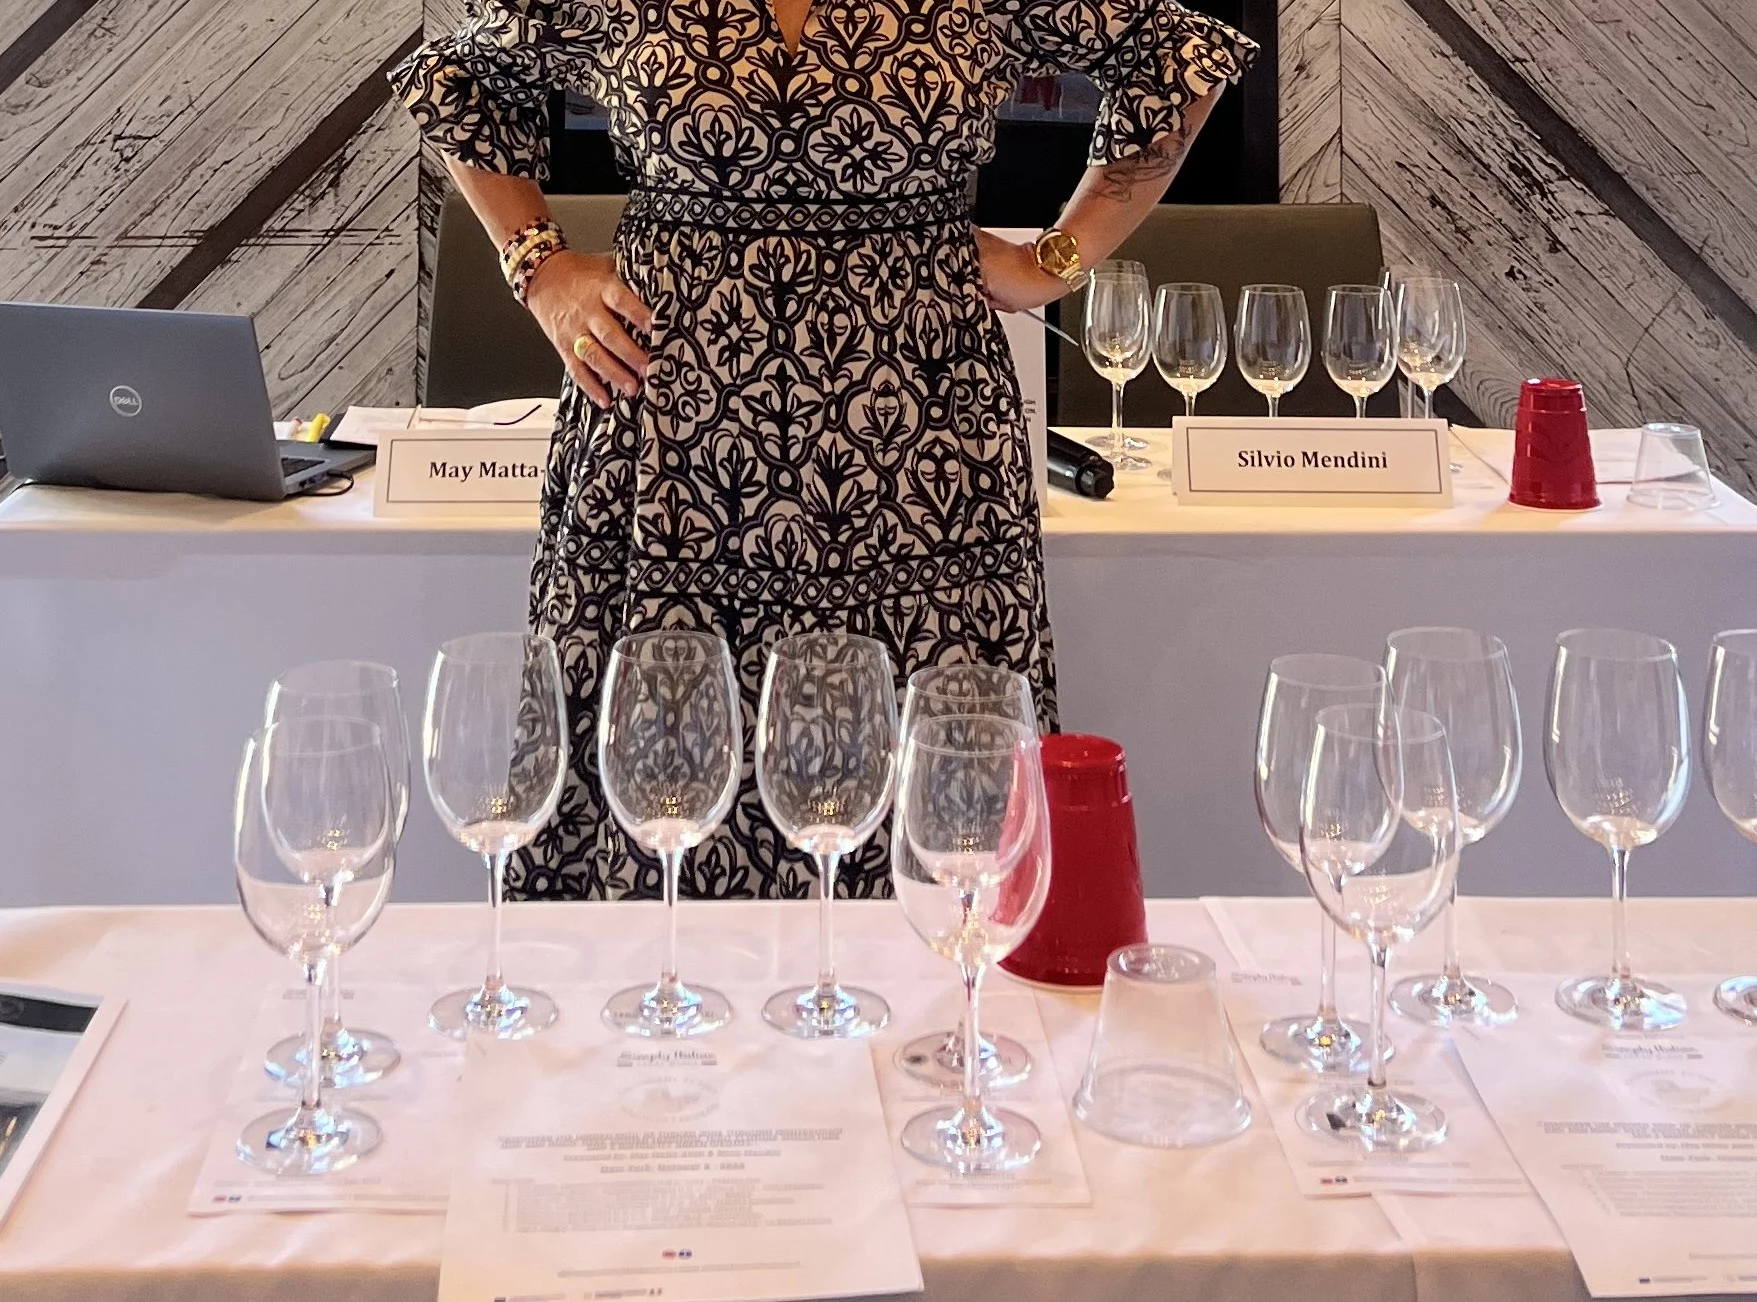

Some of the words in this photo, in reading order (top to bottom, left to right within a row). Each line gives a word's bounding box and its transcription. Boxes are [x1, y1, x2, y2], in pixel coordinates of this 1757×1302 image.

[1238, 449, 1296, 468] Silvio
[1301, 450, 1388, 469] Mendini
[429, 461, 474, 483] May
